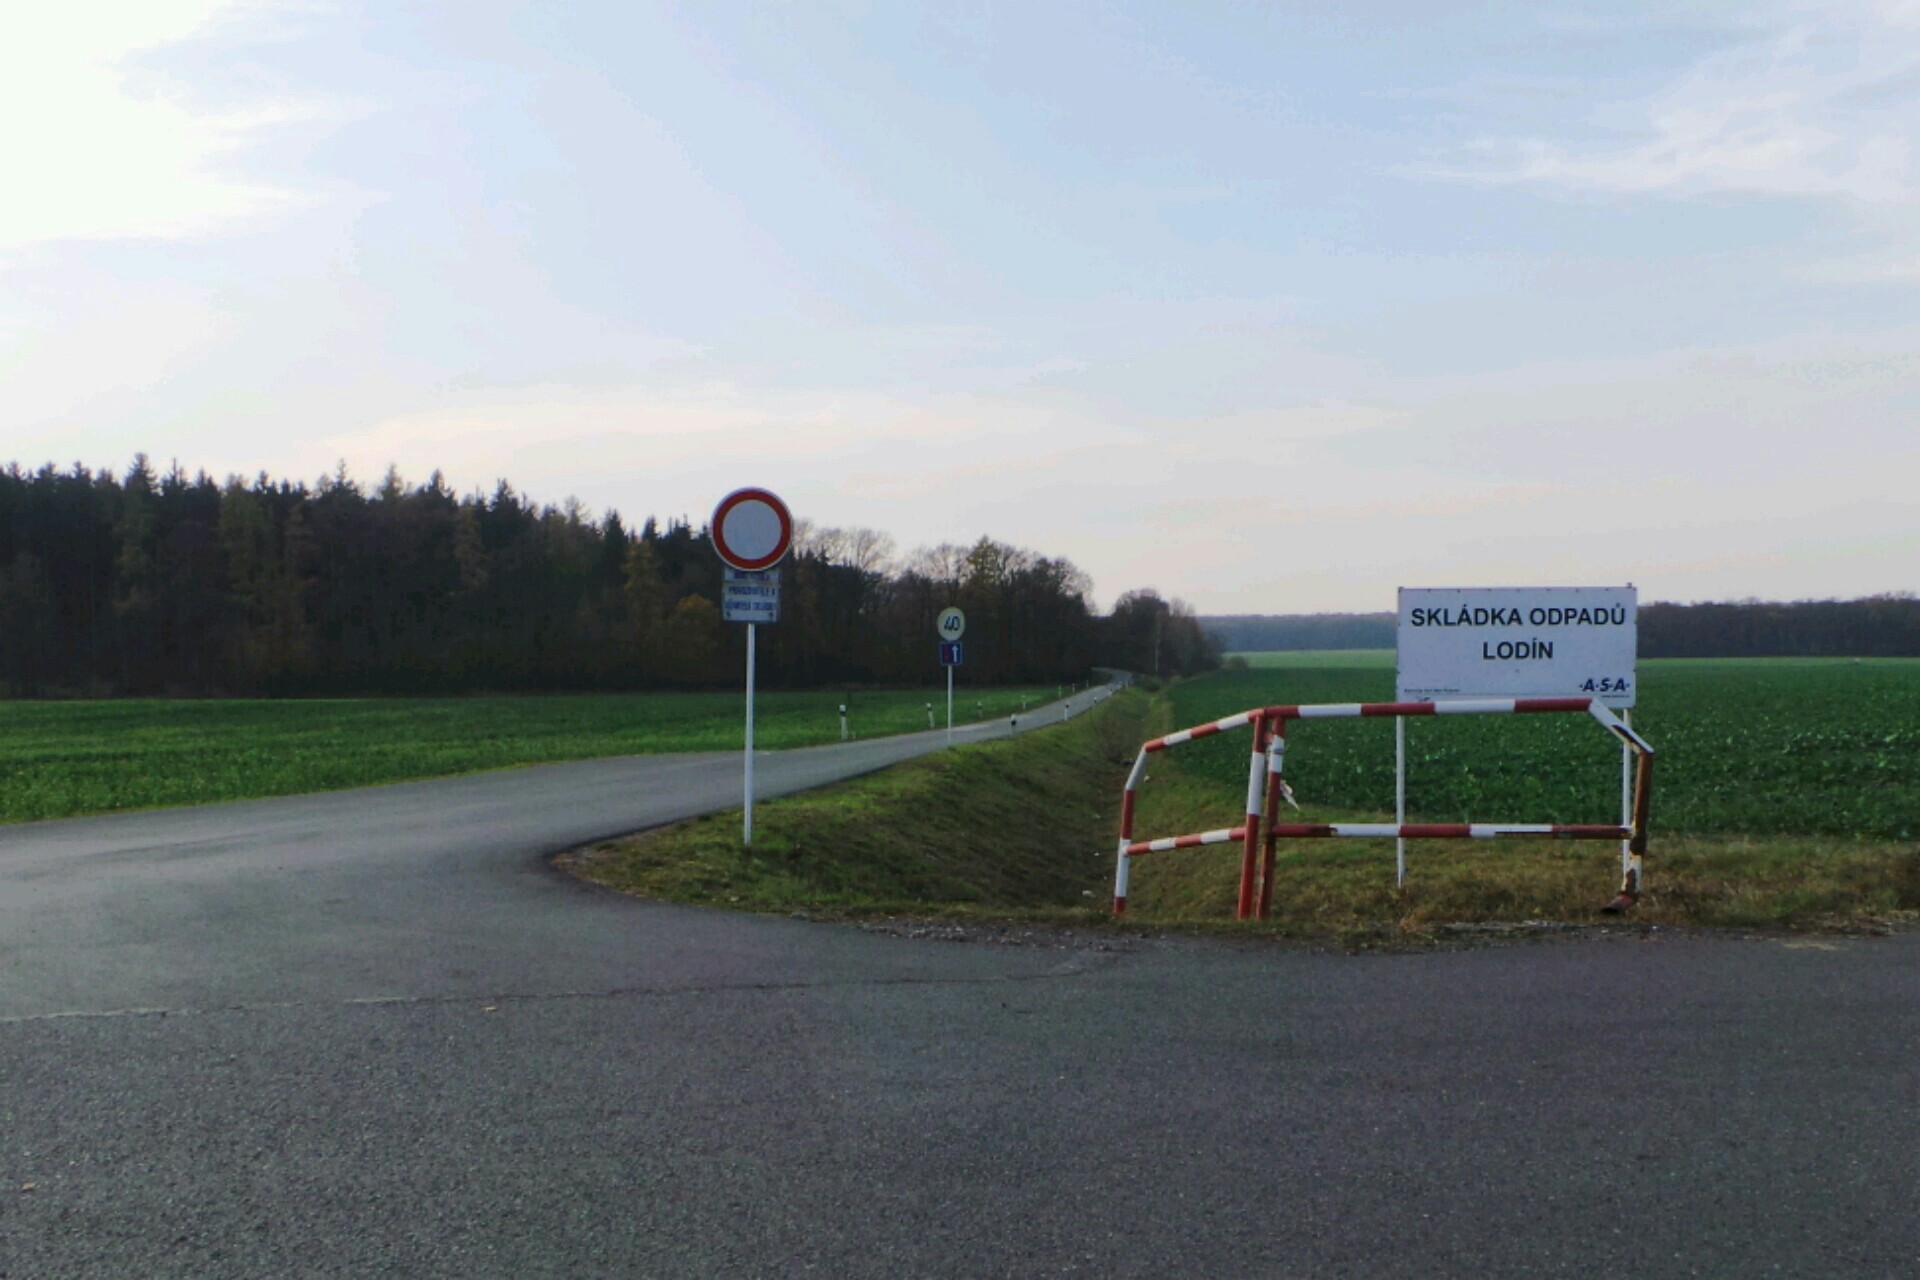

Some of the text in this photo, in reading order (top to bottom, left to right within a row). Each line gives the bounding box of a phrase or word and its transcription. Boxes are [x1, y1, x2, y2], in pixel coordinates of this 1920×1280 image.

[943, 615, 961, 631] 40
[1411, 602, 1626, 627] SKLÁDKA ODPADŮ
[1482, 637, 1554, 660] LODÍN
